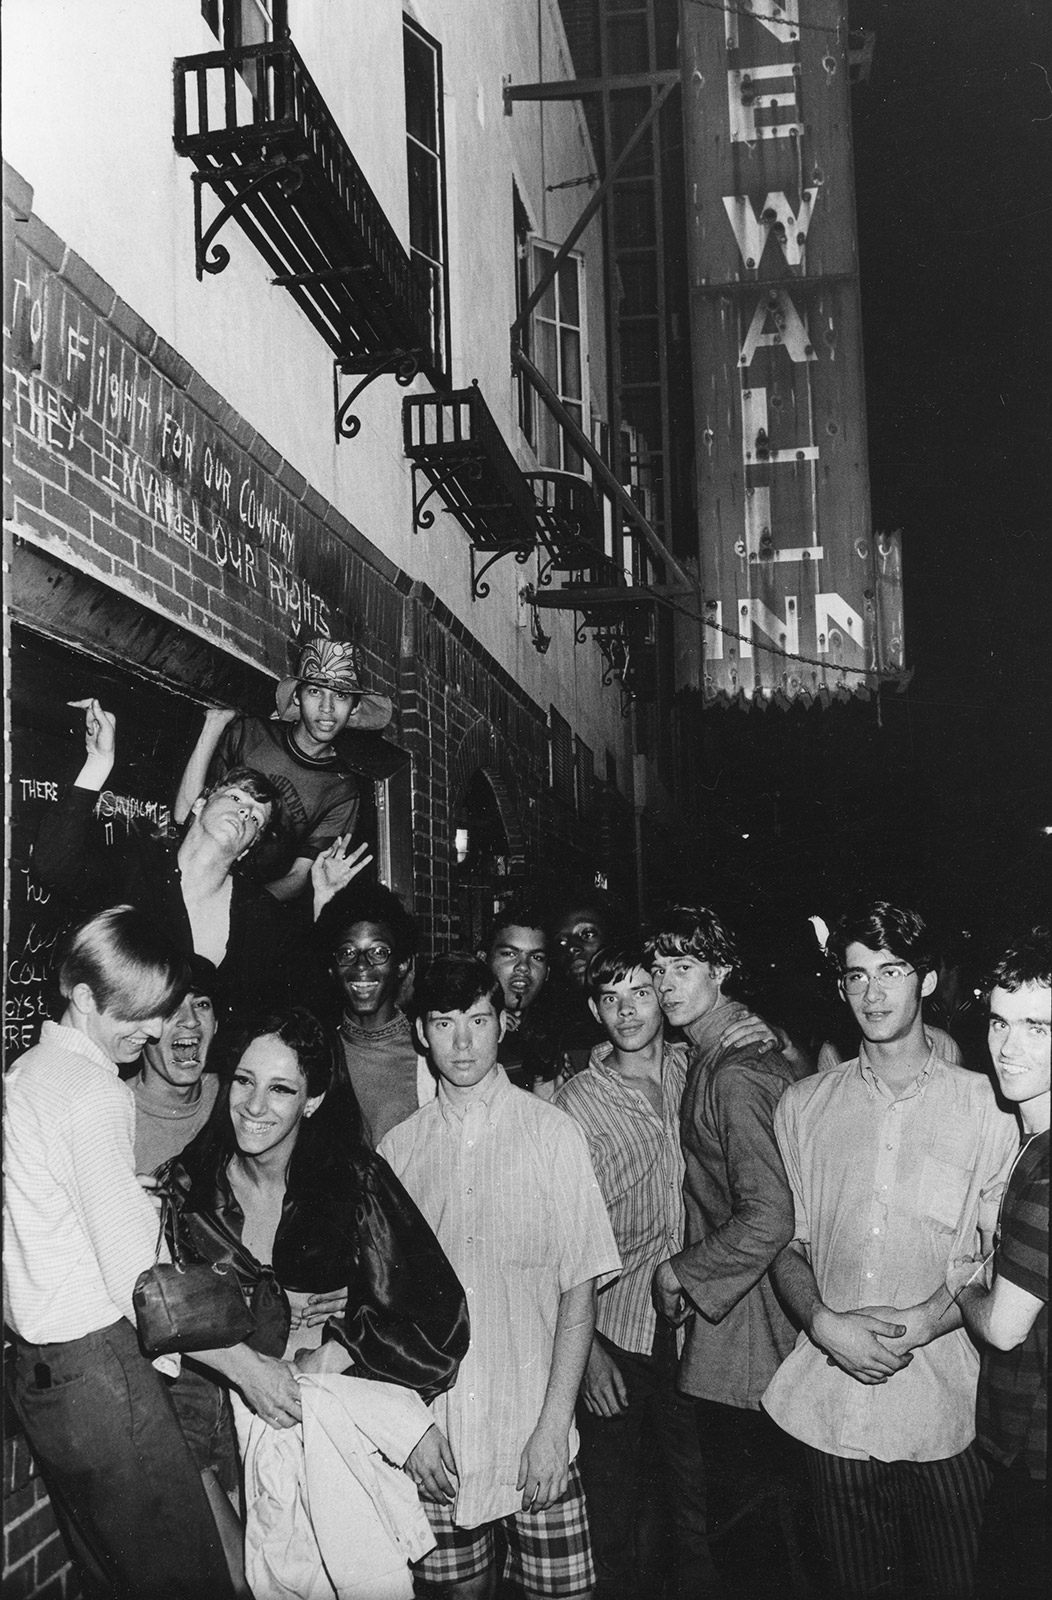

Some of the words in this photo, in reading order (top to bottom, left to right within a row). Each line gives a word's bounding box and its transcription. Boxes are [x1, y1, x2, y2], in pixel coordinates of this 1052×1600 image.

[12, 278, 42, 345] TO
[162, 412, 193, 478] FOR
[203, 446, 232, 510] OUR
[11, 368, 78, 451] THEY
[213, 519, 257, 588] OUR
[702, 592, 866, 660] INN
[19, 778, 59, 802] THERE
